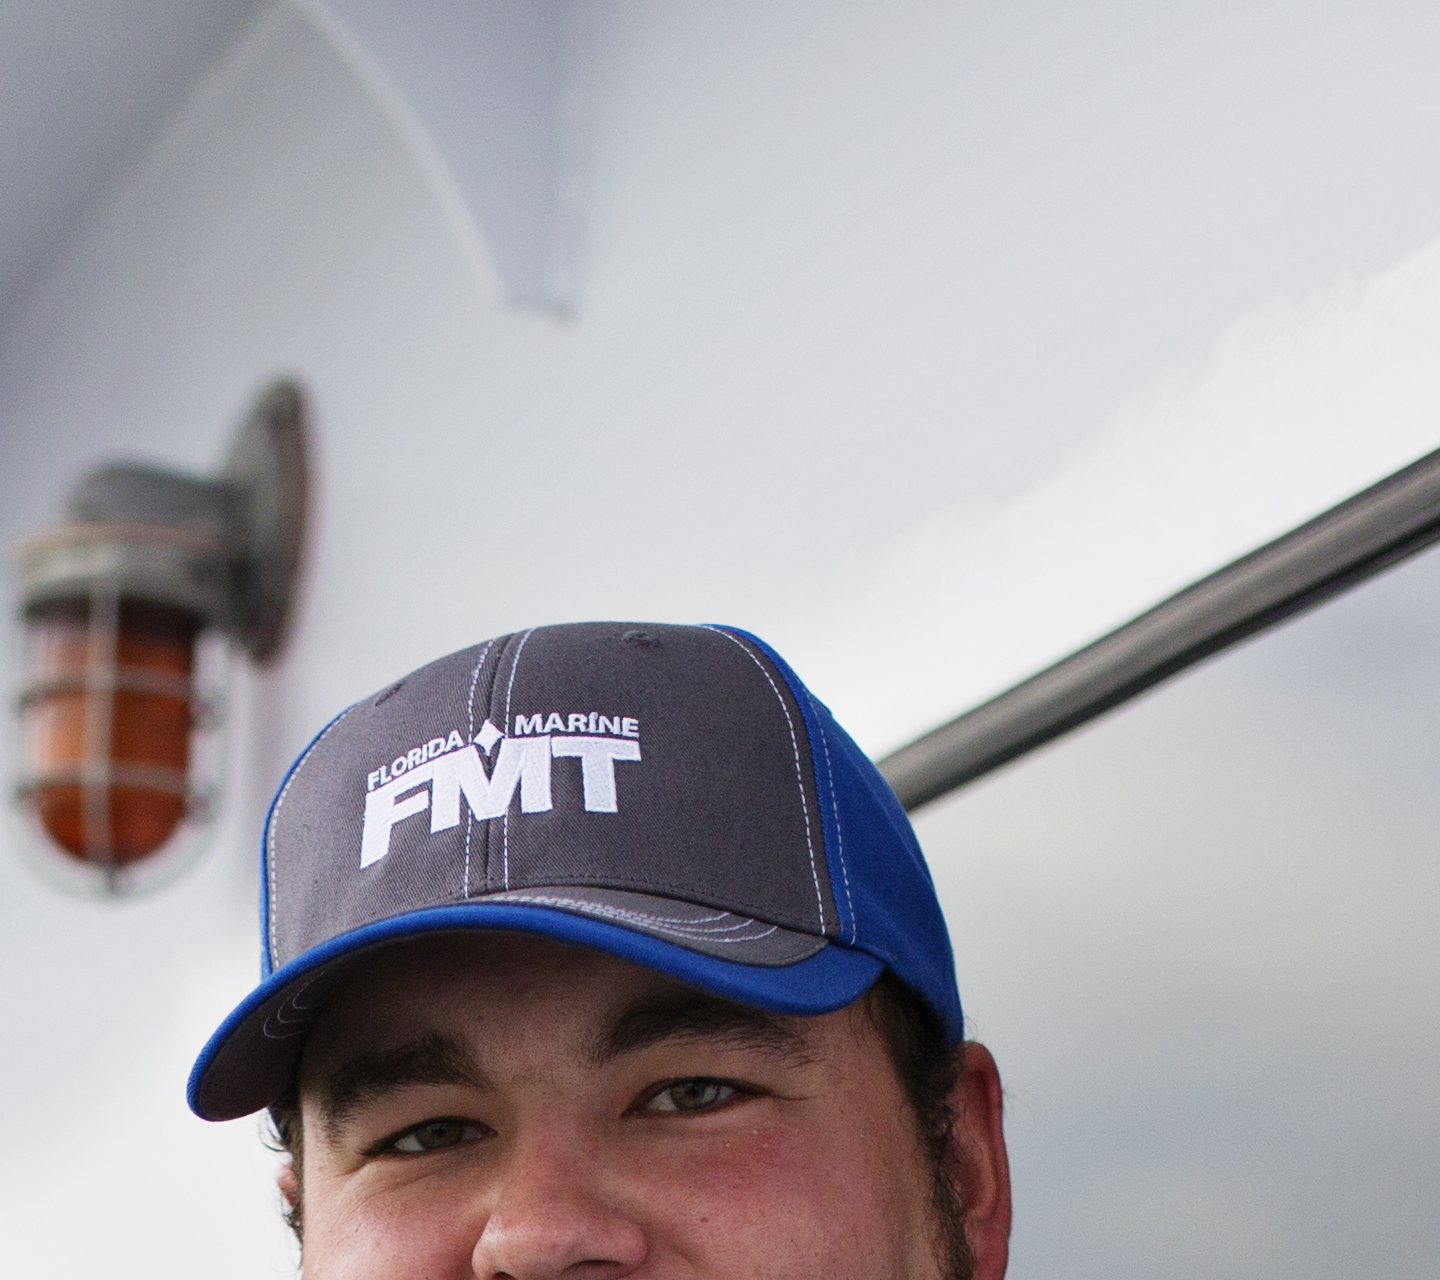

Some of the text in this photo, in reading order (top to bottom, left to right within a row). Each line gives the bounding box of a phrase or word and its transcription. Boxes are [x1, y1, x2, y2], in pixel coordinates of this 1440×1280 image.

[360, 734, 642, 870] FMT
[366, 711, 640, 792] FLORIDA MARINE
